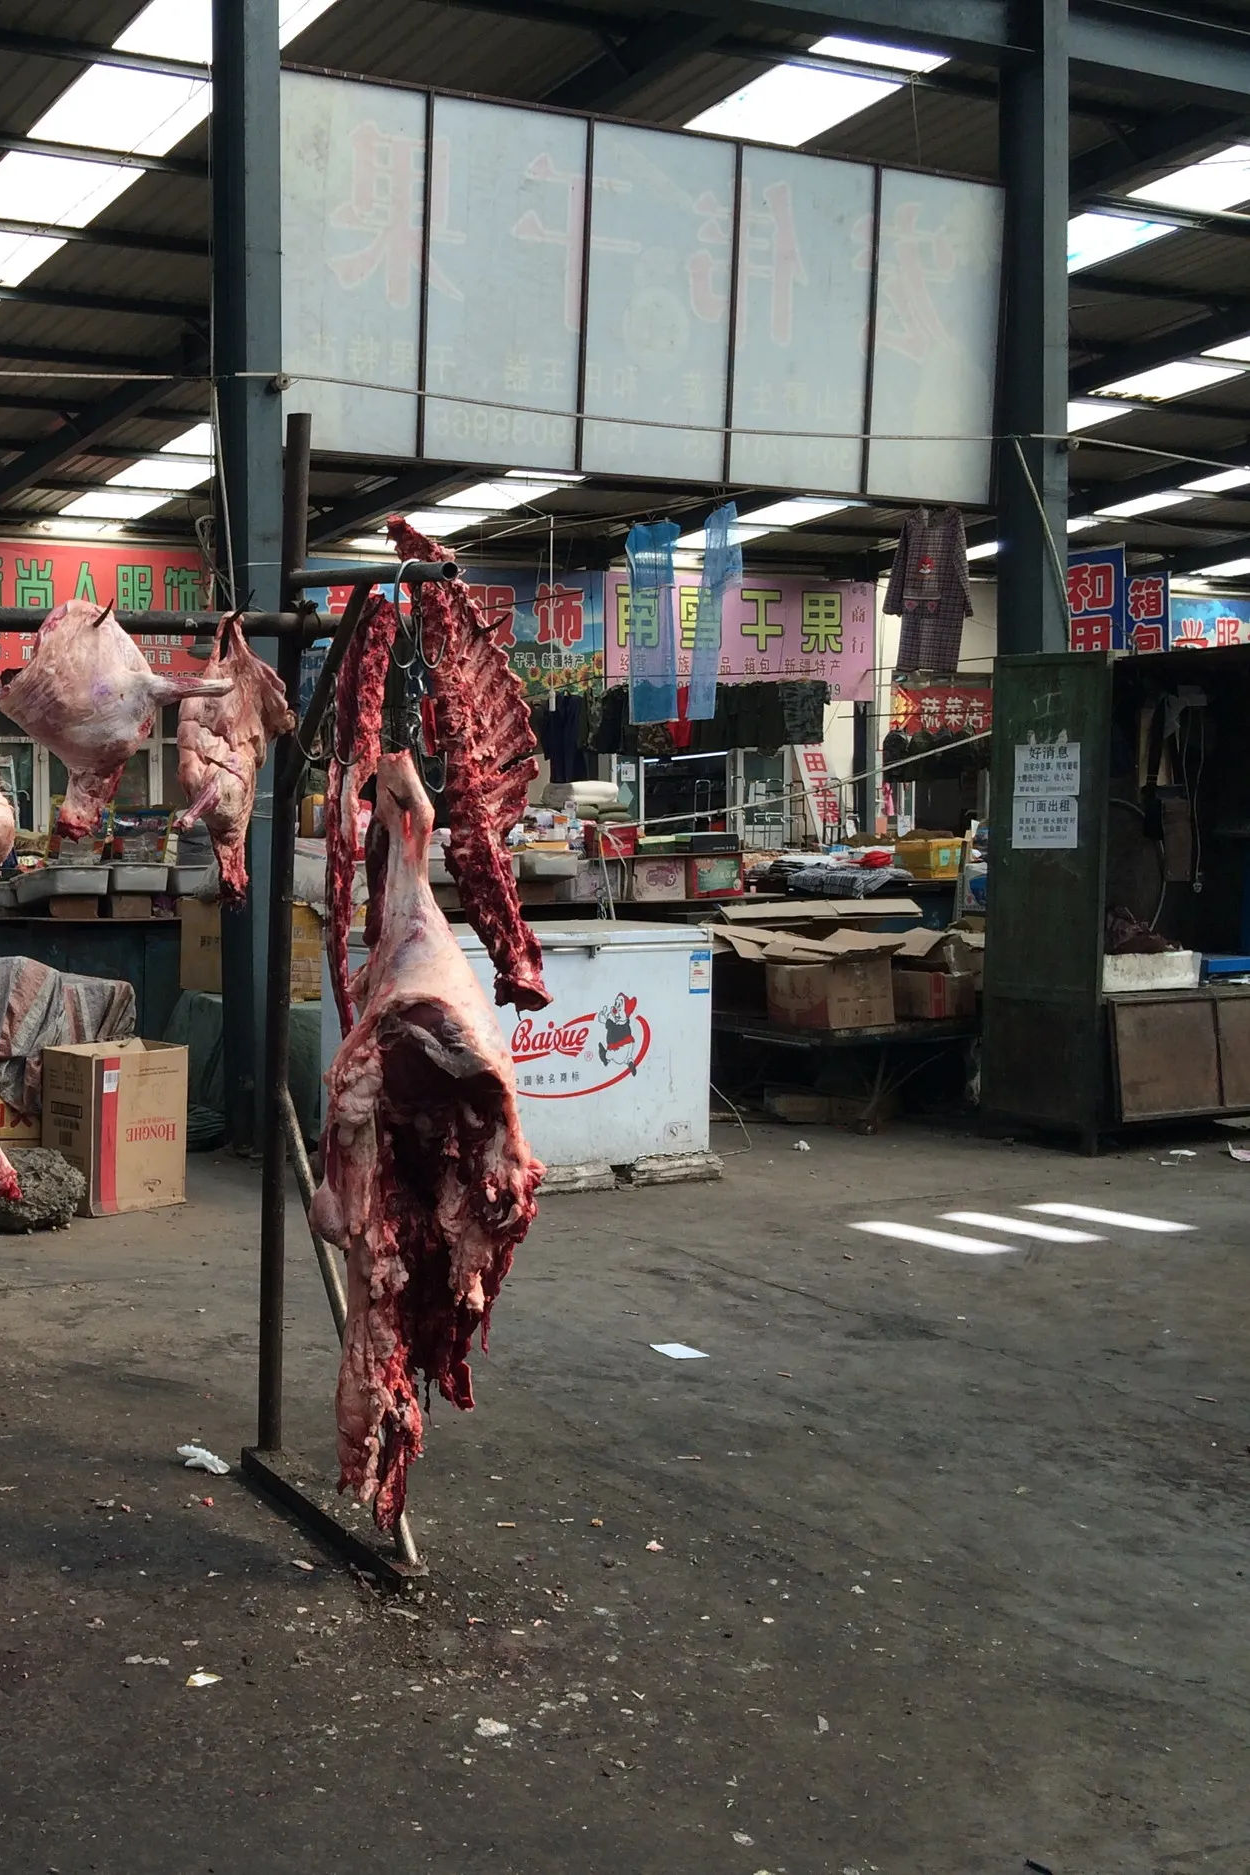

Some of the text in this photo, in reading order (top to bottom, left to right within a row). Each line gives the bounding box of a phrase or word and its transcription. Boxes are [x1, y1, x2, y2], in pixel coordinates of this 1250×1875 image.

[784, 658, 841, 678] 新疆特产
[1029, 745, 1069, 760] 好消息
[803, 743, 841, 824] 田玉器
[1024, 800, 1071, 813] 门面出租
[125, 1123, 176, 1142] HONGHE
